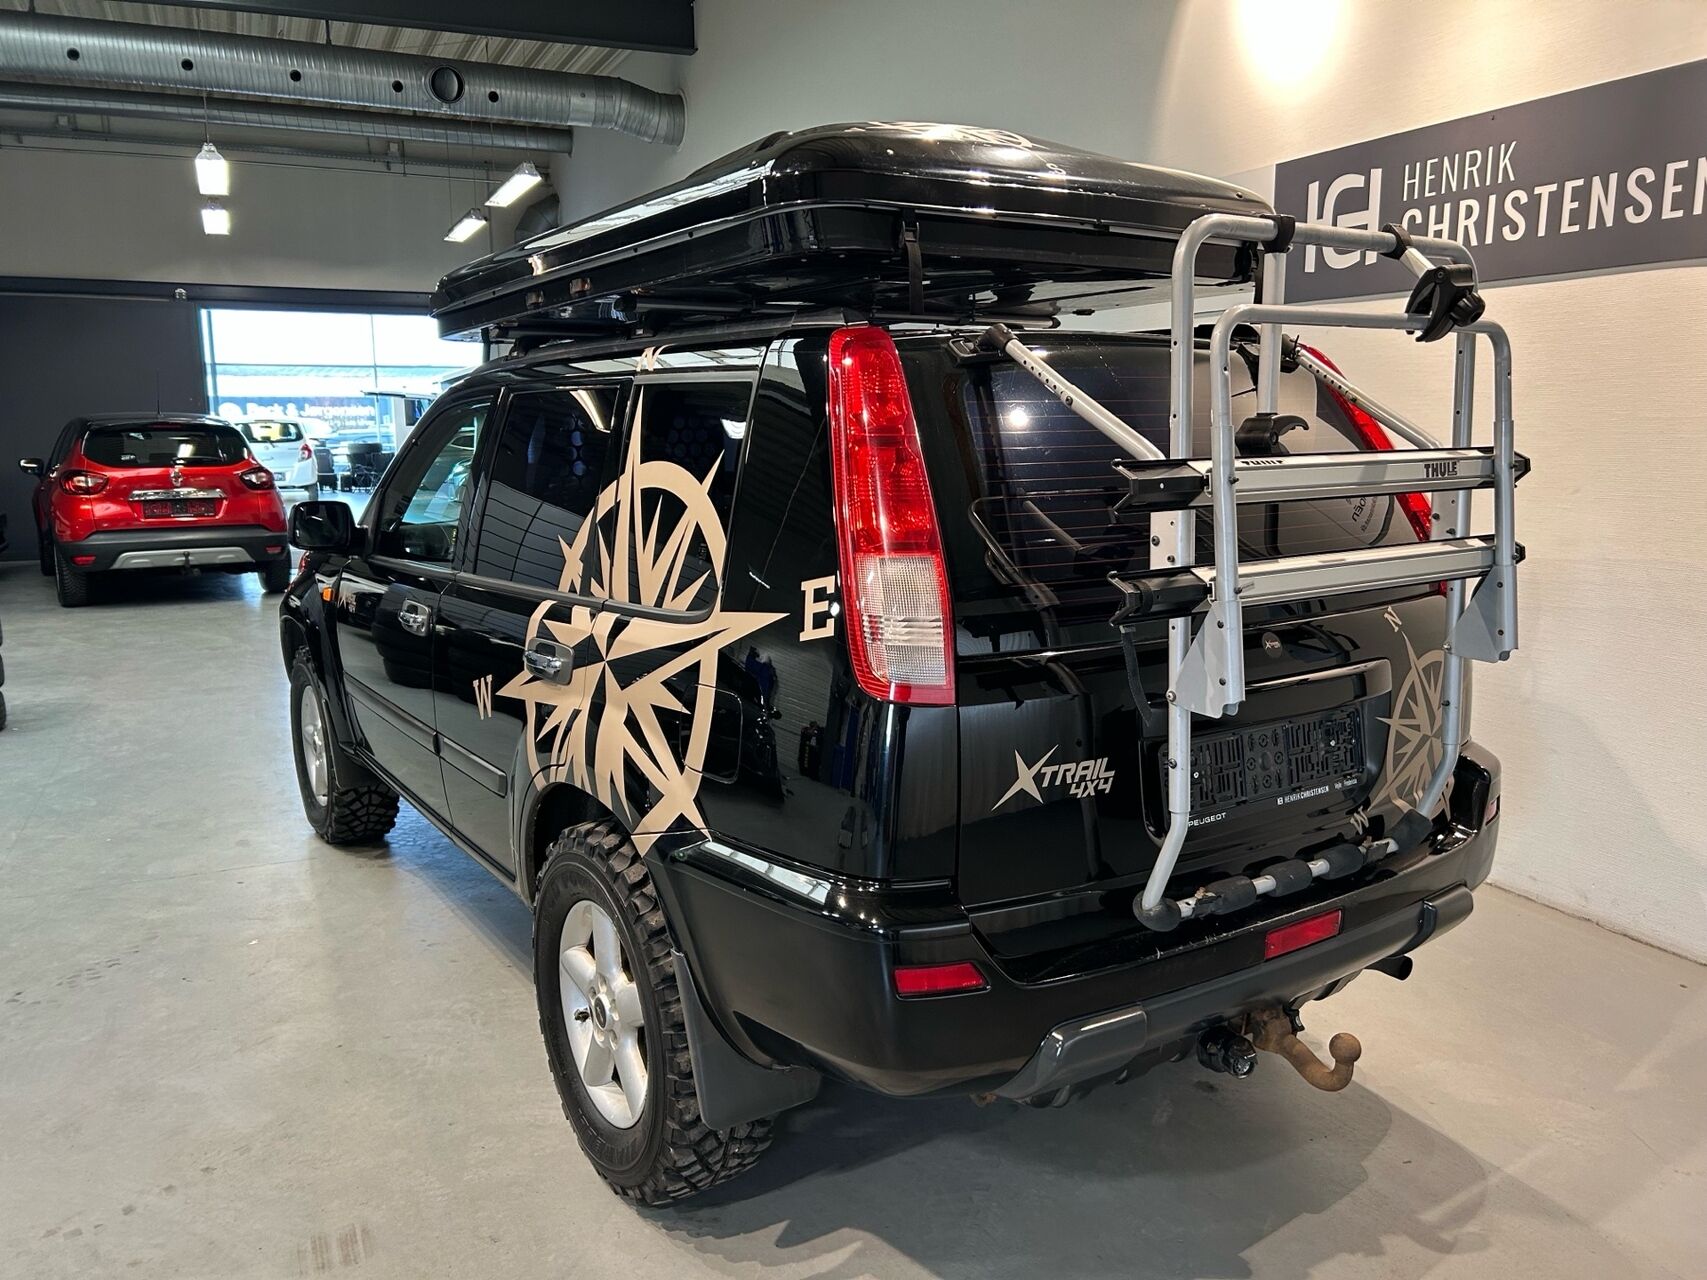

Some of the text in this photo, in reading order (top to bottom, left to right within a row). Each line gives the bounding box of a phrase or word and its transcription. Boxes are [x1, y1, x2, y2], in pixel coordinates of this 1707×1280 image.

[1402, 140, 1517, 202] HENRIK
[1424, 461, 1458, 478] THULE
[800, 575, 836, 642] E
[472, 674, 493, 720] W
[1300, 785, 1329, 799] CHRISTENSEN
[1188, 812, 1227, 827] PEUGEOT
